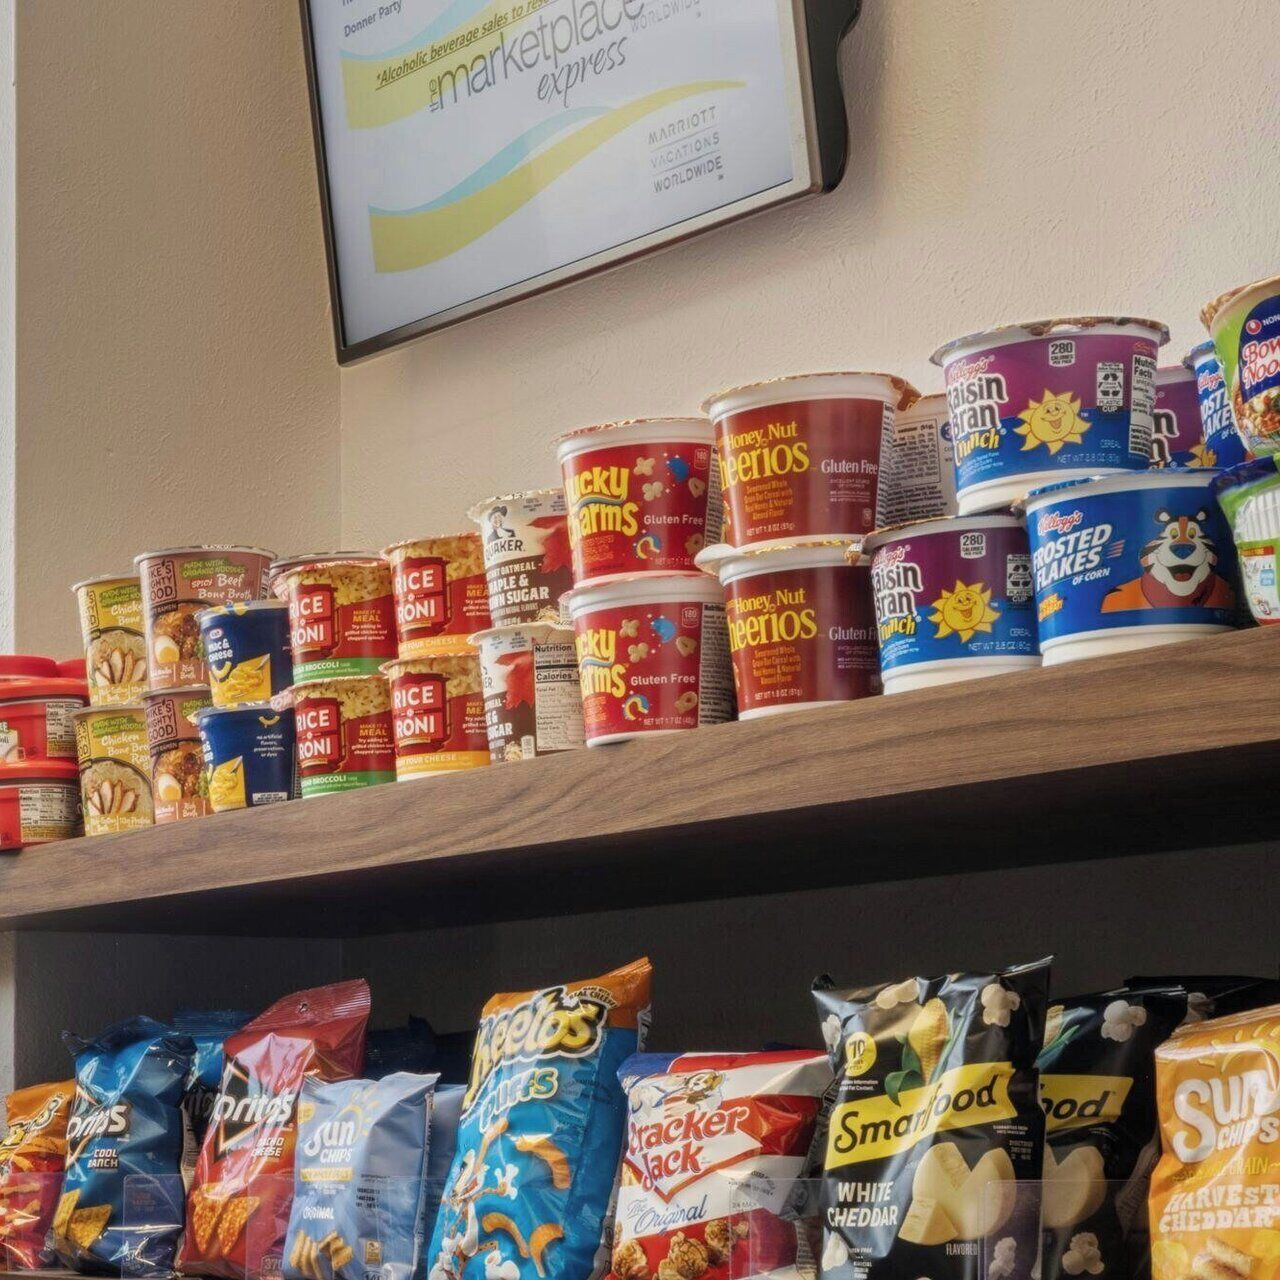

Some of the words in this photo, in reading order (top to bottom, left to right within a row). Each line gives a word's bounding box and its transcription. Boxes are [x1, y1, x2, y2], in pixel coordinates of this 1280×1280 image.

[344, 13, 377, 38] Donner
[430, 27, 479, 59] beverage
[482, 12, 509, 36] sales
[438, 0, 644, 109] marketplace
[538, 37, 627, 107] express
[648, 106, 717, 145] MARRIOTT
[653, 156, 722, 193] WORLDWIDE
[1050, 342, 1073, 354] 280
[769, 421, 797, 438] Nut
[821, 460, 859, 474] Gluten
[644, 515, 679, 525] Gluten
[682, 515, 703, 525] Free
[962, 535, 984, 546] 280
[1034, 525, 1112, 570] FROSTED
[217, 574, 245, 585] Beef
[1036, 546, 1102, 591] FLAKES
[1085, 568, 1110, 581] CORN
[396, 570, 434, 590] RICE
[198, 589, 224, 599] Bone
[507, 587, 549, 605] SUGAR
[776, 588, 806, 605] Nut
[353, 614, 381, 623] MEAL
[398, 600, 435, 623] RONI
[631, 675, 668, 686] Gluten
[670, 674, 696, 684] Free
[394, 685, 434, 707] RICE
[396, 714, 435, 738] RONI
[102, 734, 139, 747] Chicken
[834, 1074, 998, 1154] Smartfood
[629, 1106, 749, 1155] Cracker
[94, 1149, 118, 1158] COOL
[320, 1148, 354, 1163] CHIPS
[642, 1143, 702, 1189] Jack
[837, 1181, 894, 1203] WHITE
[1164, 1185, 1279, 1213] HARVEST
[634, 1195, 708, 1234] Original
[827, 1206, 898, 1229] CHEDDAR
